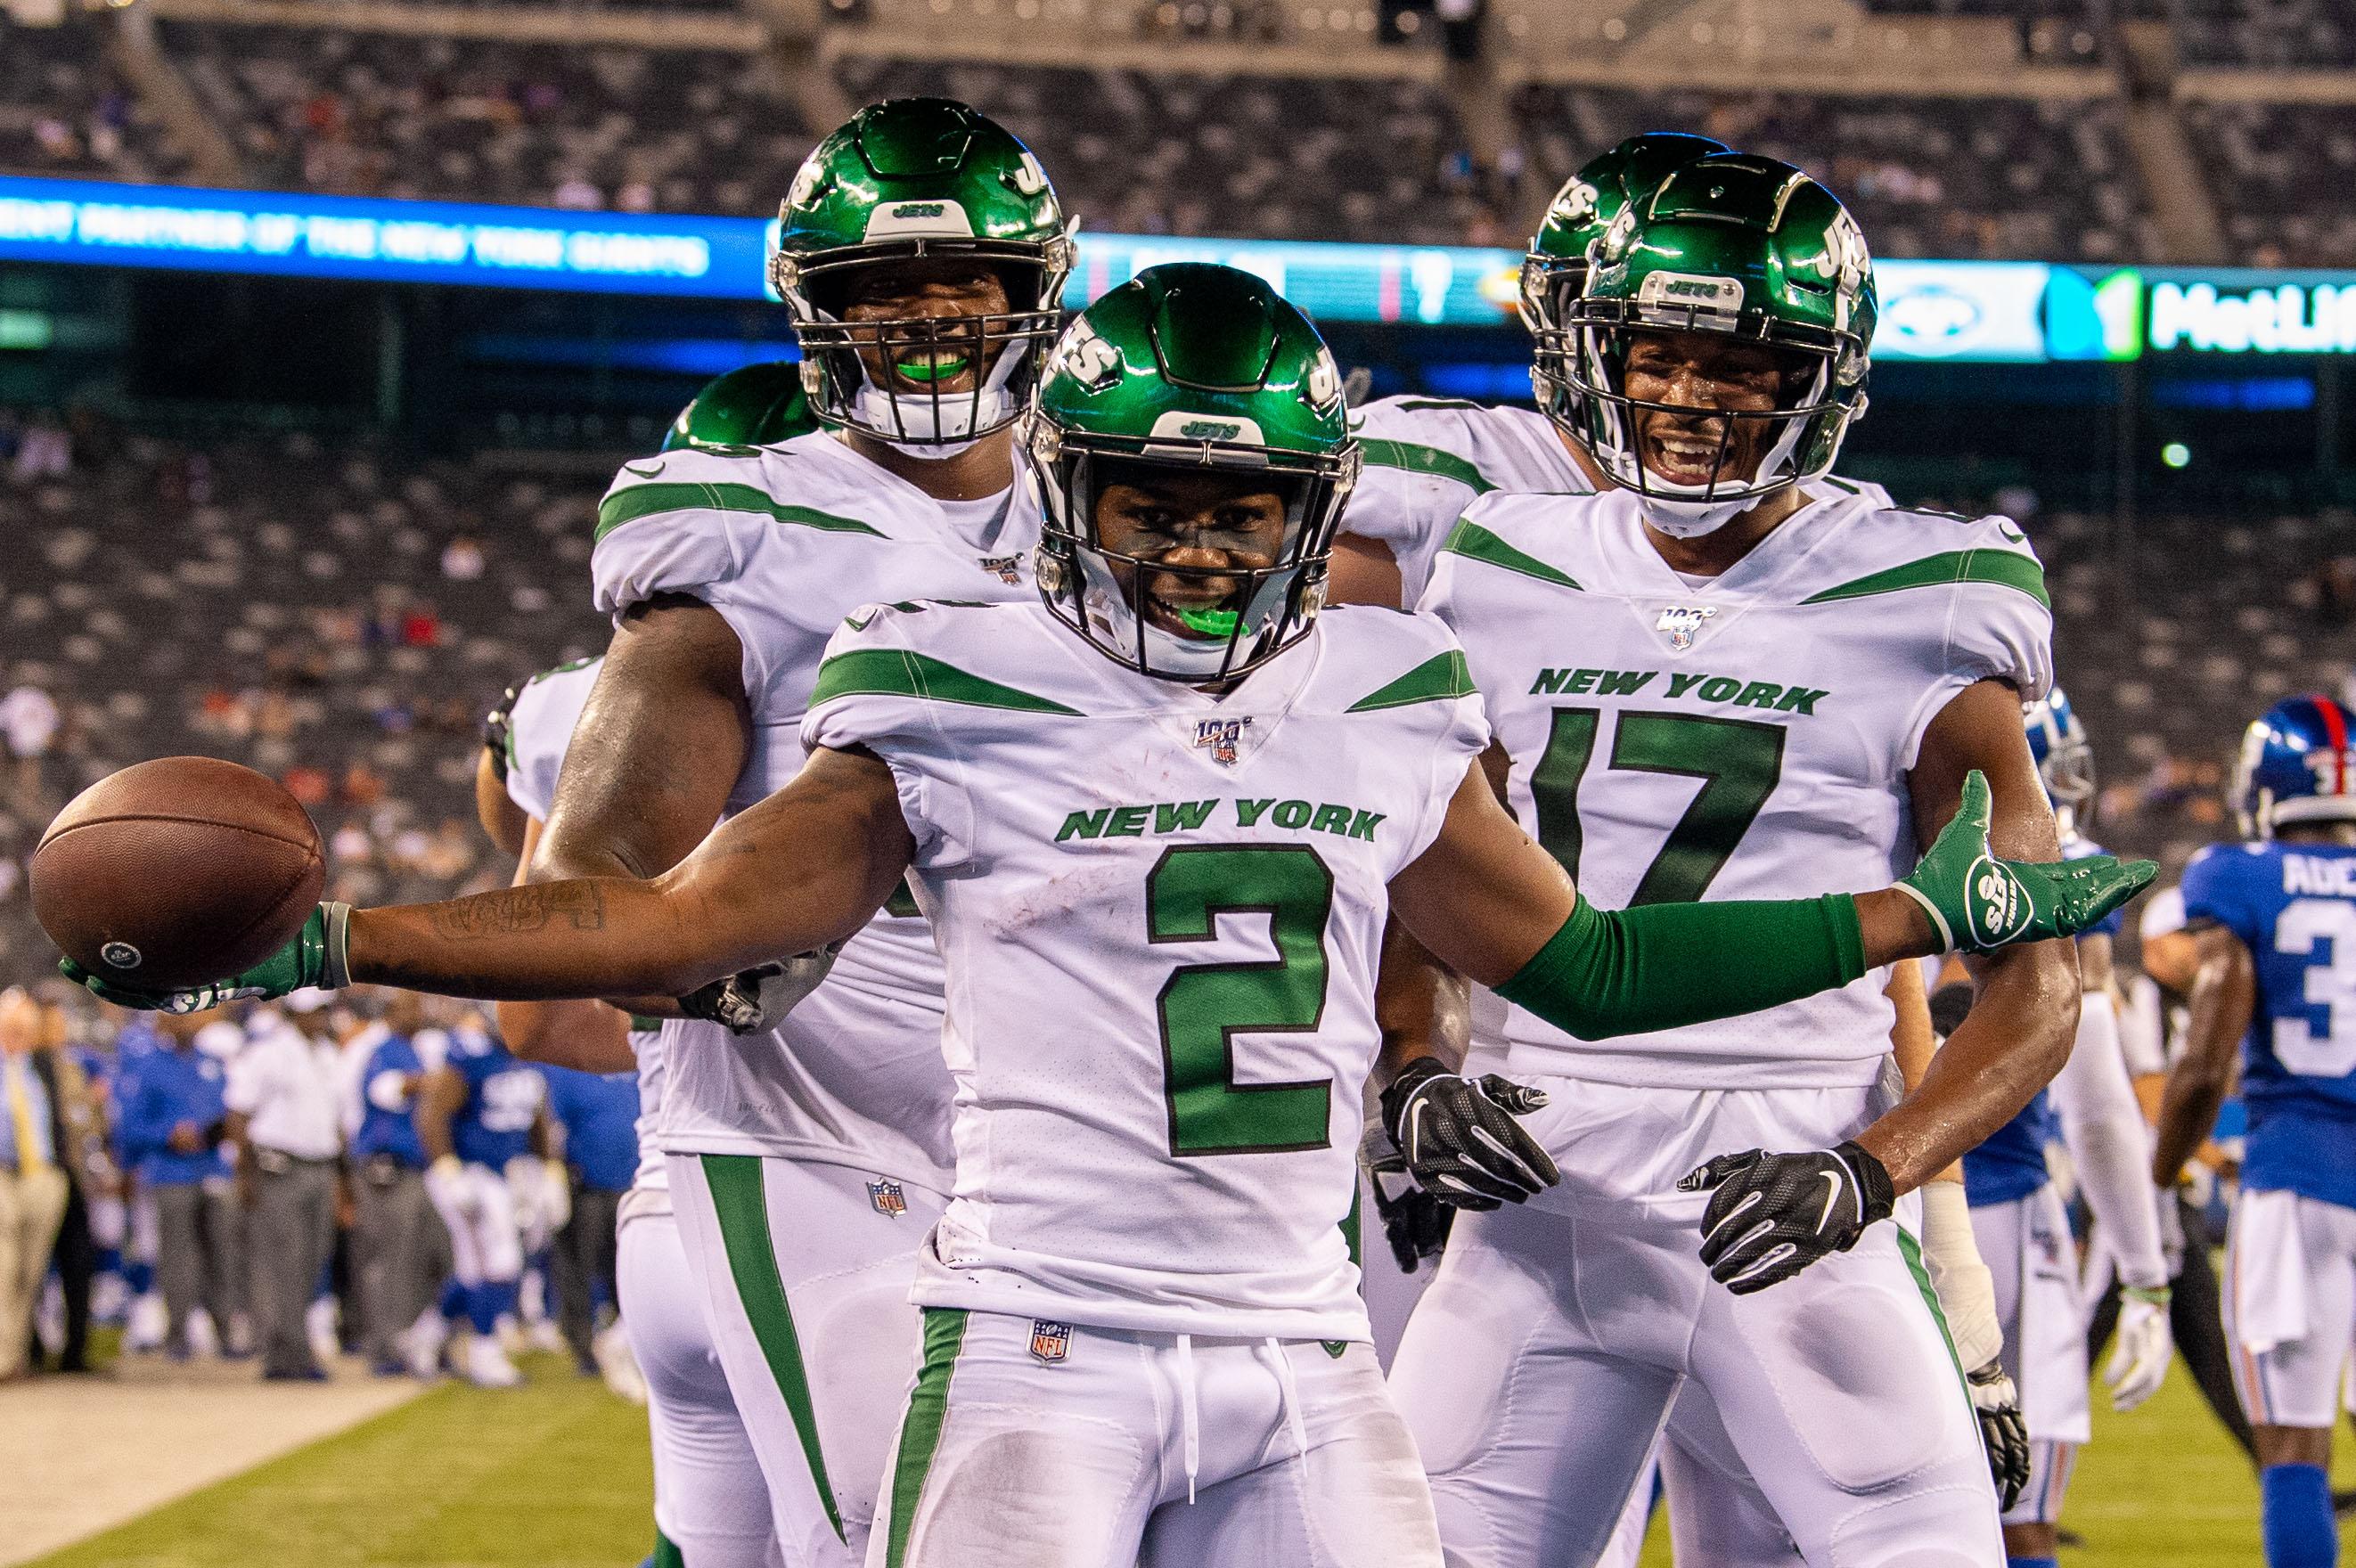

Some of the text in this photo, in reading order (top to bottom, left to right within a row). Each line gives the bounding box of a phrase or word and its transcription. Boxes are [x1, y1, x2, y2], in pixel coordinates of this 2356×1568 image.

[892, 203, 945, 217] JETS
[1666, 280, 1720, 298] JETS
[1180, 422, 1241, 440] JETS
[1527, 667, 1831, 716] NEW YORK
[1053, 797, 1387, 843] NEW YORK
[1530, 707, 1787, 909] 17
[1146, 842, 1335, 1157] 2
[1034, 1335, 1063, 1357] NFL
